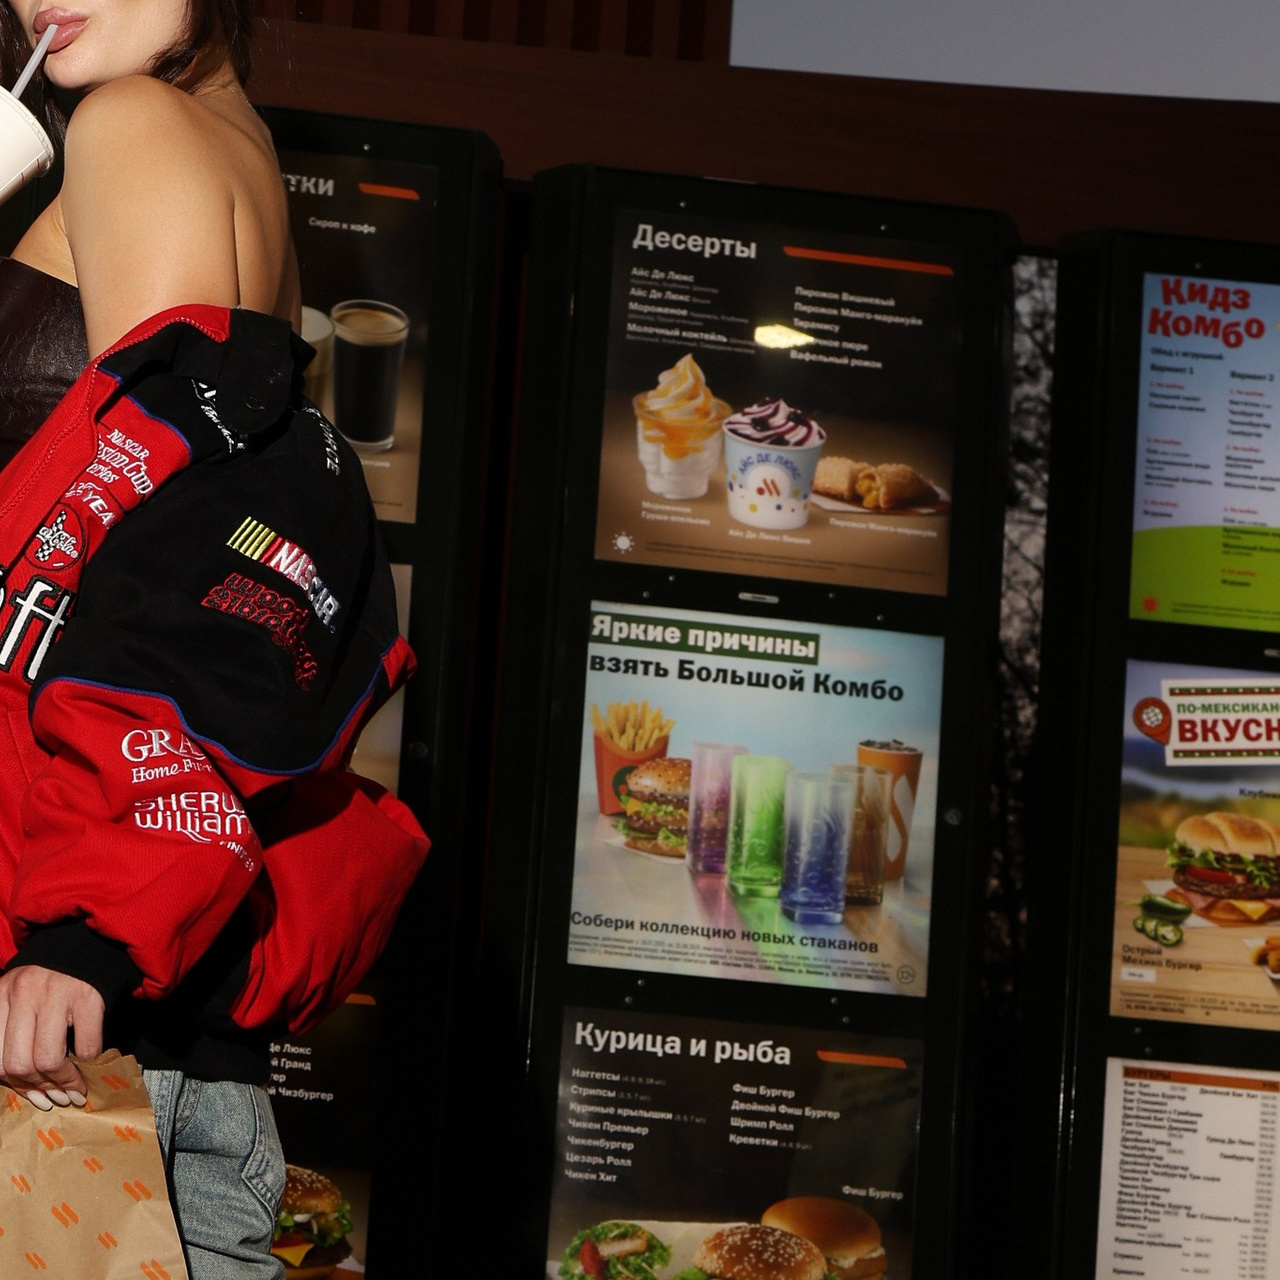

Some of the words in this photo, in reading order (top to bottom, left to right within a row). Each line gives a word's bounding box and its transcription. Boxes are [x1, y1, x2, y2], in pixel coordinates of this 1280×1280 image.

[282, 173, 335, 196] тки
[632, 223, 757, 259] Десерты
[1162, 278, 1251, 314] Кидз
[1148, 307, 1266, 349] Комбо
[106, 428, 150, 461] NASCAR
[756, 452, 772, 464] ДЕ
[83, 490, 116, 530] YEA
[269, 539, 342, 626] NASCAR
[592, 614, 682, 644] Яркие
[688, 628, 816, 658] причины
[590, 655, 669, 678] взять
[678, 660, 804, 692] Большой
[814, 673, 904, 701] Комбо
[1177, 703, 1280, 714] ПО-МЕКСИКАН
[1178, 718, 1280, 742] ВКУСН
[131, 762, 182, 784] Home
[571, 912, 634, 931] Собери
[640, 920, 736, 939] коллекцию
[740, 930, 795, 945] новых
[800, 935, 878, 952] стаканов
[282, 1044, 312, 1056] Люкс
[575, 1022, 682, 1058] Курица
[689, 1038, 707, 1057] и
[714, 1040, 792, 1066] рыба
[280, 1058, 312, 1072] Гранд
[572, 1068, 621, 1082] Наггетсы
[278, 1086, 334, 1102] Чизбургер
[570, 1085, 616, 1098] Стрипсы
[759, 1085, 796, 1099] Бургер
